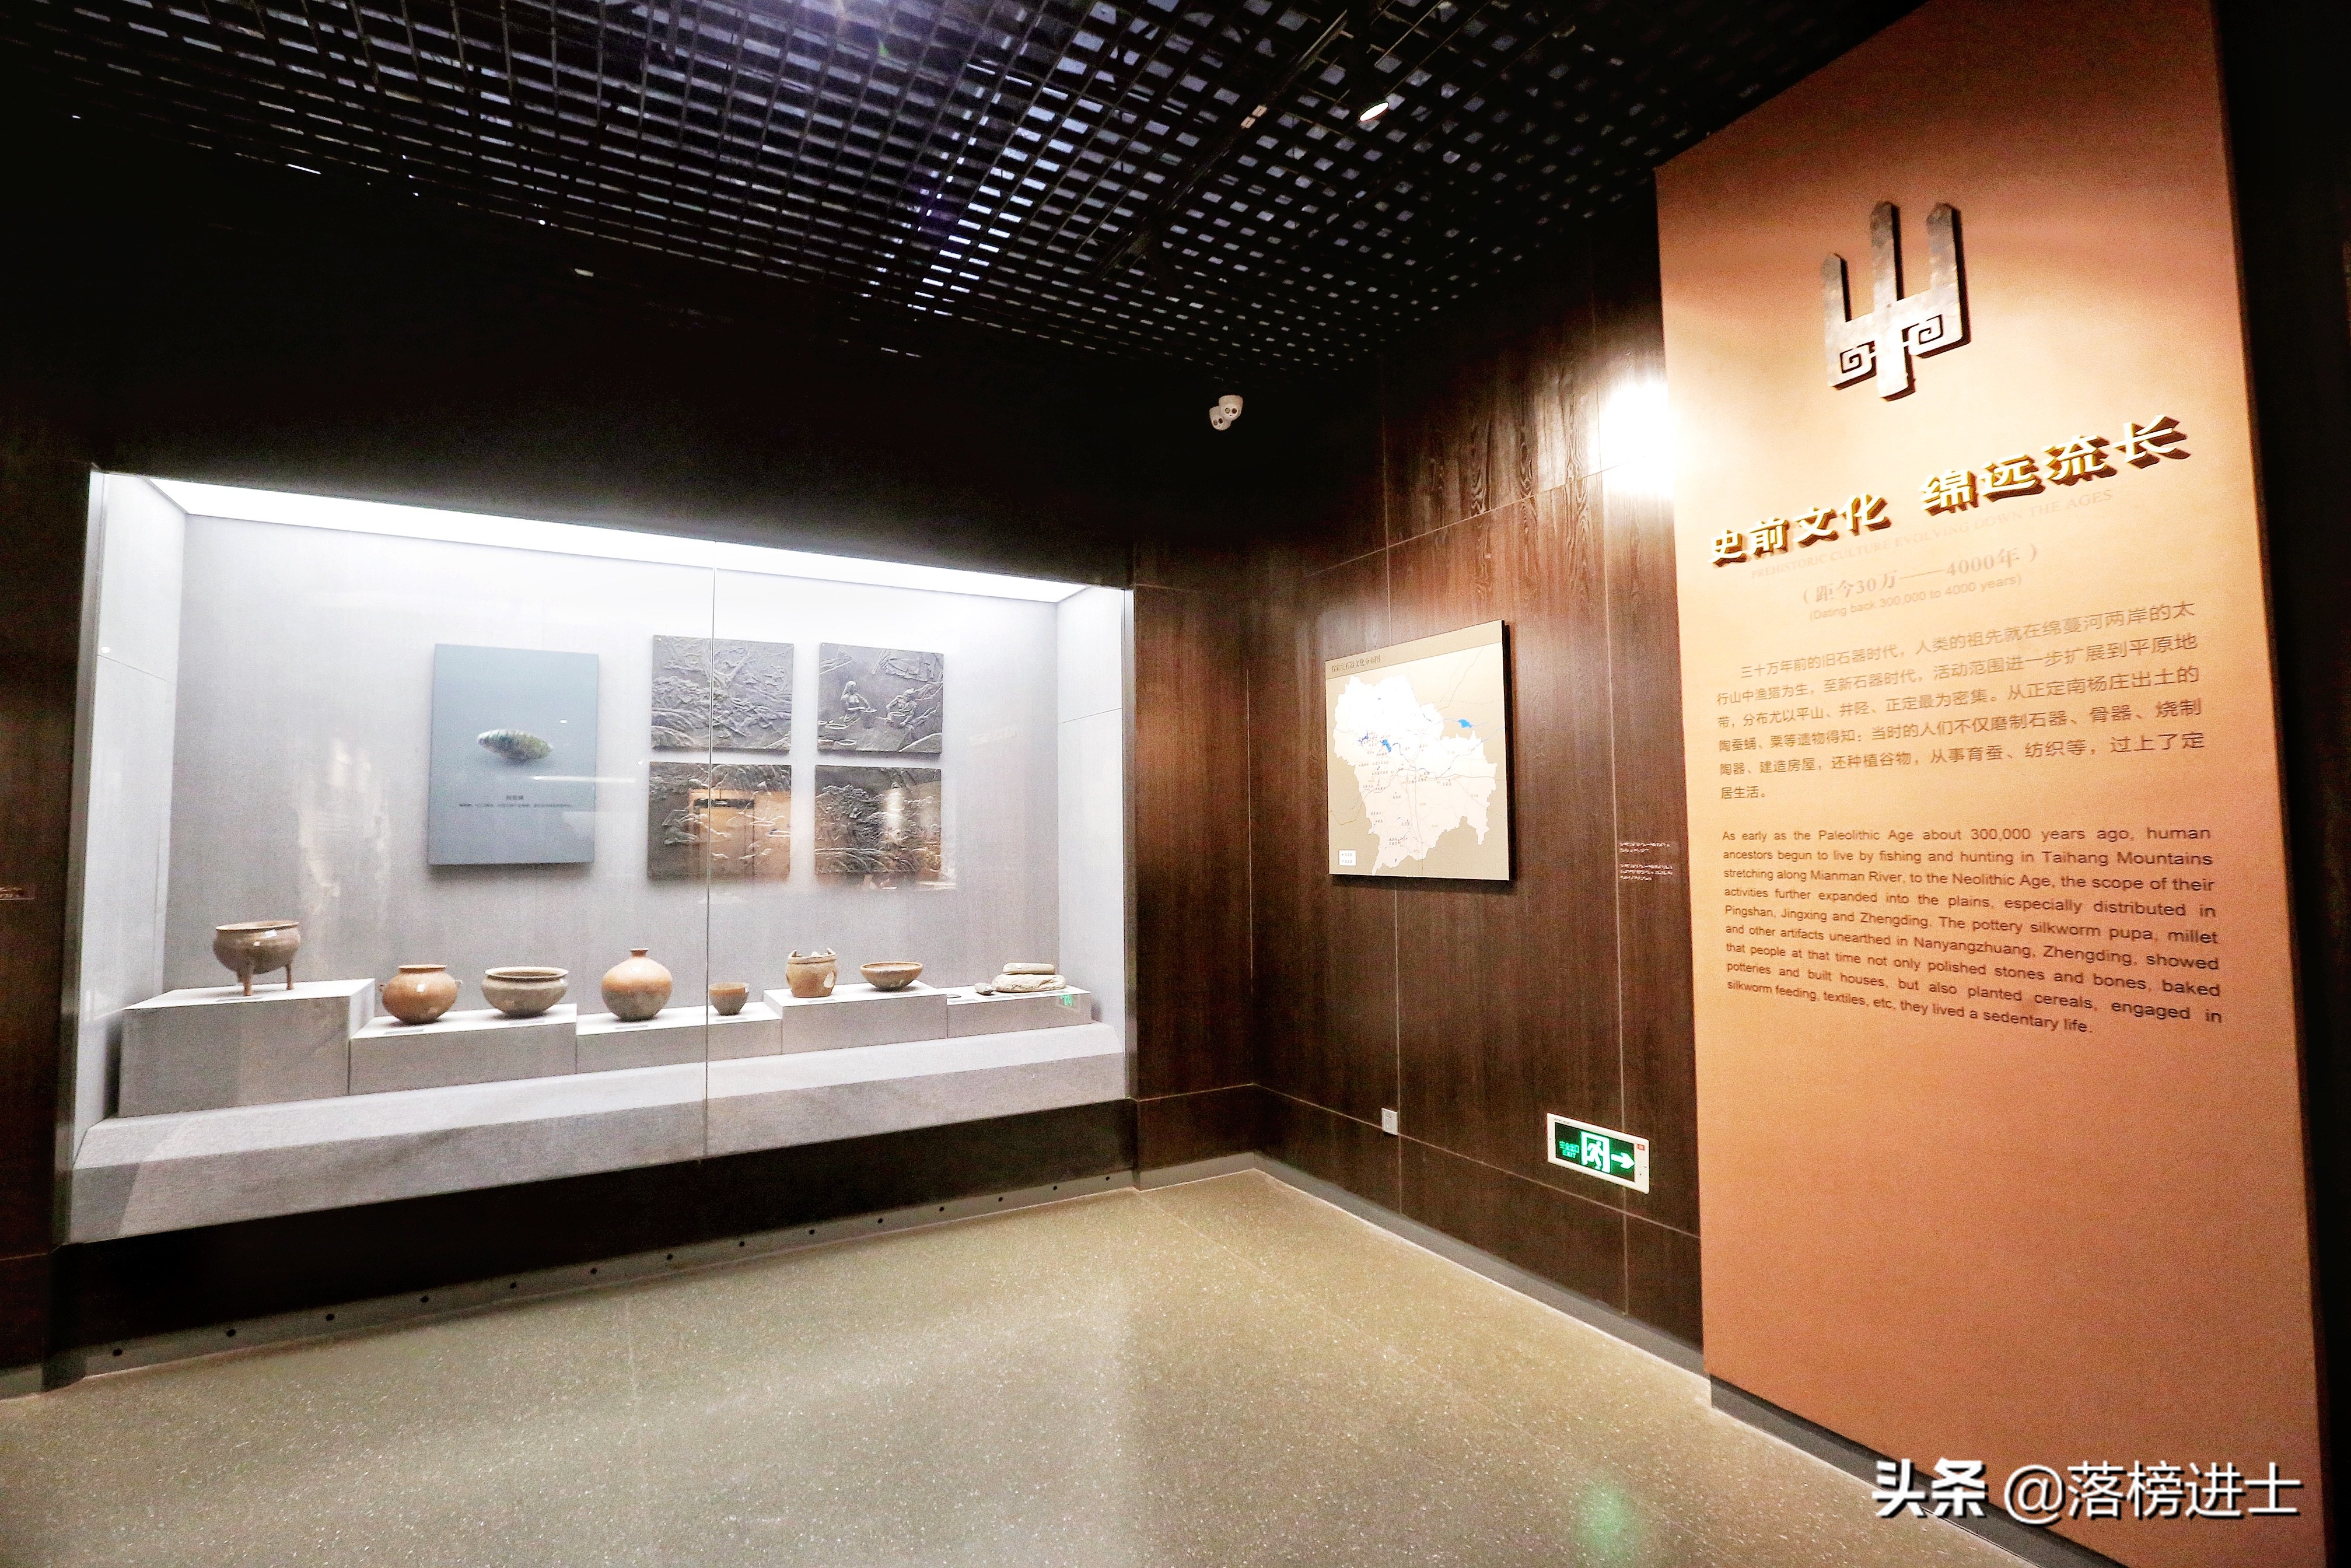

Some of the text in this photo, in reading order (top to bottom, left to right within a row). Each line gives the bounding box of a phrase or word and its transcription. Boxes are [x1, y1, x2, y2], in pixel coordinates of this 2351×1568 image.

[1709, 414, 2189, 566] 史前文化 绵远流长
[1751, 558, 1825, 579] PREHISTORIC
[1829, 540, 1891, 561] CULTURE
[2031, 502, 2060, 517] THE
[2066, 489, 2112, 509] AGES
[1851, 601, 1875, 612] back
[1930, 589, 1941, 598] to
[1946, 582, 1976, 596] 4000
[1980, 575, 2021, 592] years)
[1721, 785, 1766, 800] 居生活。
[1723, 831, 1735, 840] As
[1742, 831, 1766, 842] early
[1794, 831, 1811, 840] the
[1819, 830, 1880, 840] Paleolithic
[1888, 830, 1913, 842] Age
[1923, 830, 1961, 840] about
[1971, 828, 2031, 841] 300,000
[2042, 830, 2085, 842] years
[2097, 829, 2134, 842] ago,
[2147, 827, 2210, 839] human
[1723, 850, 2213, 866] ancestors begun to live by fishing and hunting in Taihang Mountains
[1724, 869, 2214, 891] stretching along Mianman River, to the Neolithic Age, the scope of their
[1724, 888, 2216, 918] activities further expanded into the plains, especially distributed in
[1781, 908, 1827, 922] Jingxing
[1832, 912, 1854, 922] and
[1938, 916, 1965, 929] The
[1972, 920, 2023, 935] pottery
[2031, 922, 2100, 936] silkworm
[2109, 928, 2157, 942] pupa,
[2168, 930, 2217, 943] millet
[1726, 925, 1744, 934] and
[1749, 926, 1775, 936] other
[1780, 929, 1824, 940] artifacts
[1829, 933, 1891, 945] unearthed
[1897, 936, 1908, 946] in
[1914, 936, 2035, 958] Nanyangzhuang,
[2146, 953, 2219, 970] showed
[1726, 943, 2220, 996] that people at that time not only polished stones and bones, baked
[1727, 963, 2221, 1023] potteries and built houses, but also planted cereals, engaged in
[1727, 981, 1772, 994] silkworm
[1900, 999, 1928, 1015] they
[1932, 1003, 1964, 1017] lived
[1969, 1010, 1978, 1019] a
[1983, 1011, 2058, 1031] sedentary
[2063, 1018, 2093, 1032] life.
[1563, 1150, 1576, 1158] EXIT
